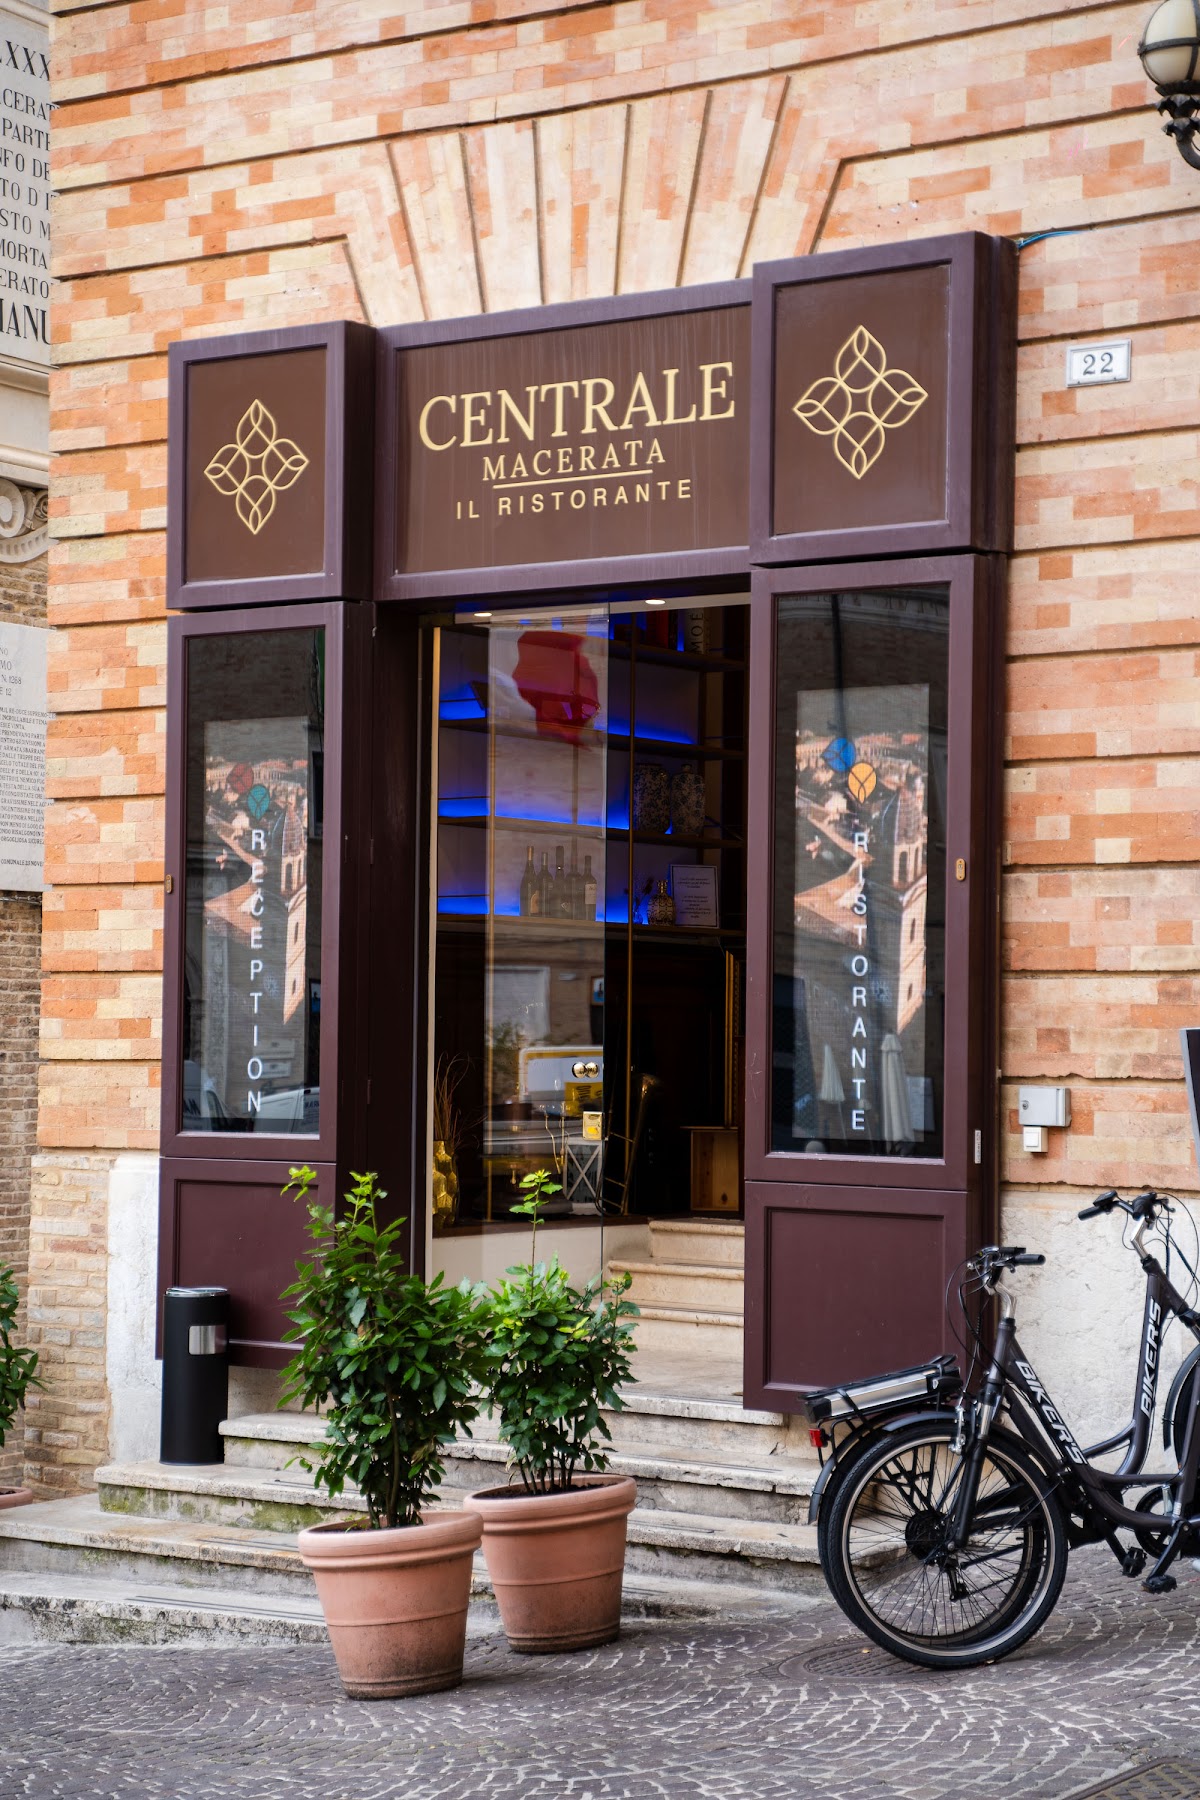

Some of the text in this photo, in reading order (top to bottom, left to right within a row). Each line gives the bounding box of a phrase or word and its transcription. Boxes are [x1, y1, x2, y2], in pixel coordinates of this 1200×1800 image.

[0, 40, 51, 82] XXX
[0, 88, 60, 121] CERAT
[0, 208, 32, 235] STO
[0, 267, 54, 299] ERATO
[1082, 352, 1114, 376] 22
[418, 360, 736, 452] CENTRALE
[481, 437, 666, 482] MACERATA
[456, 478, 692, 520] IL RISTORANTE
[246, 828, 267, 1114] RECEPTION
[850, 831, 870, 1132] RISTORANTE
[1140, 1299, 1161, 1419] BIKER'S
[1015, 1360, 1089, 1466] BIKER'S
